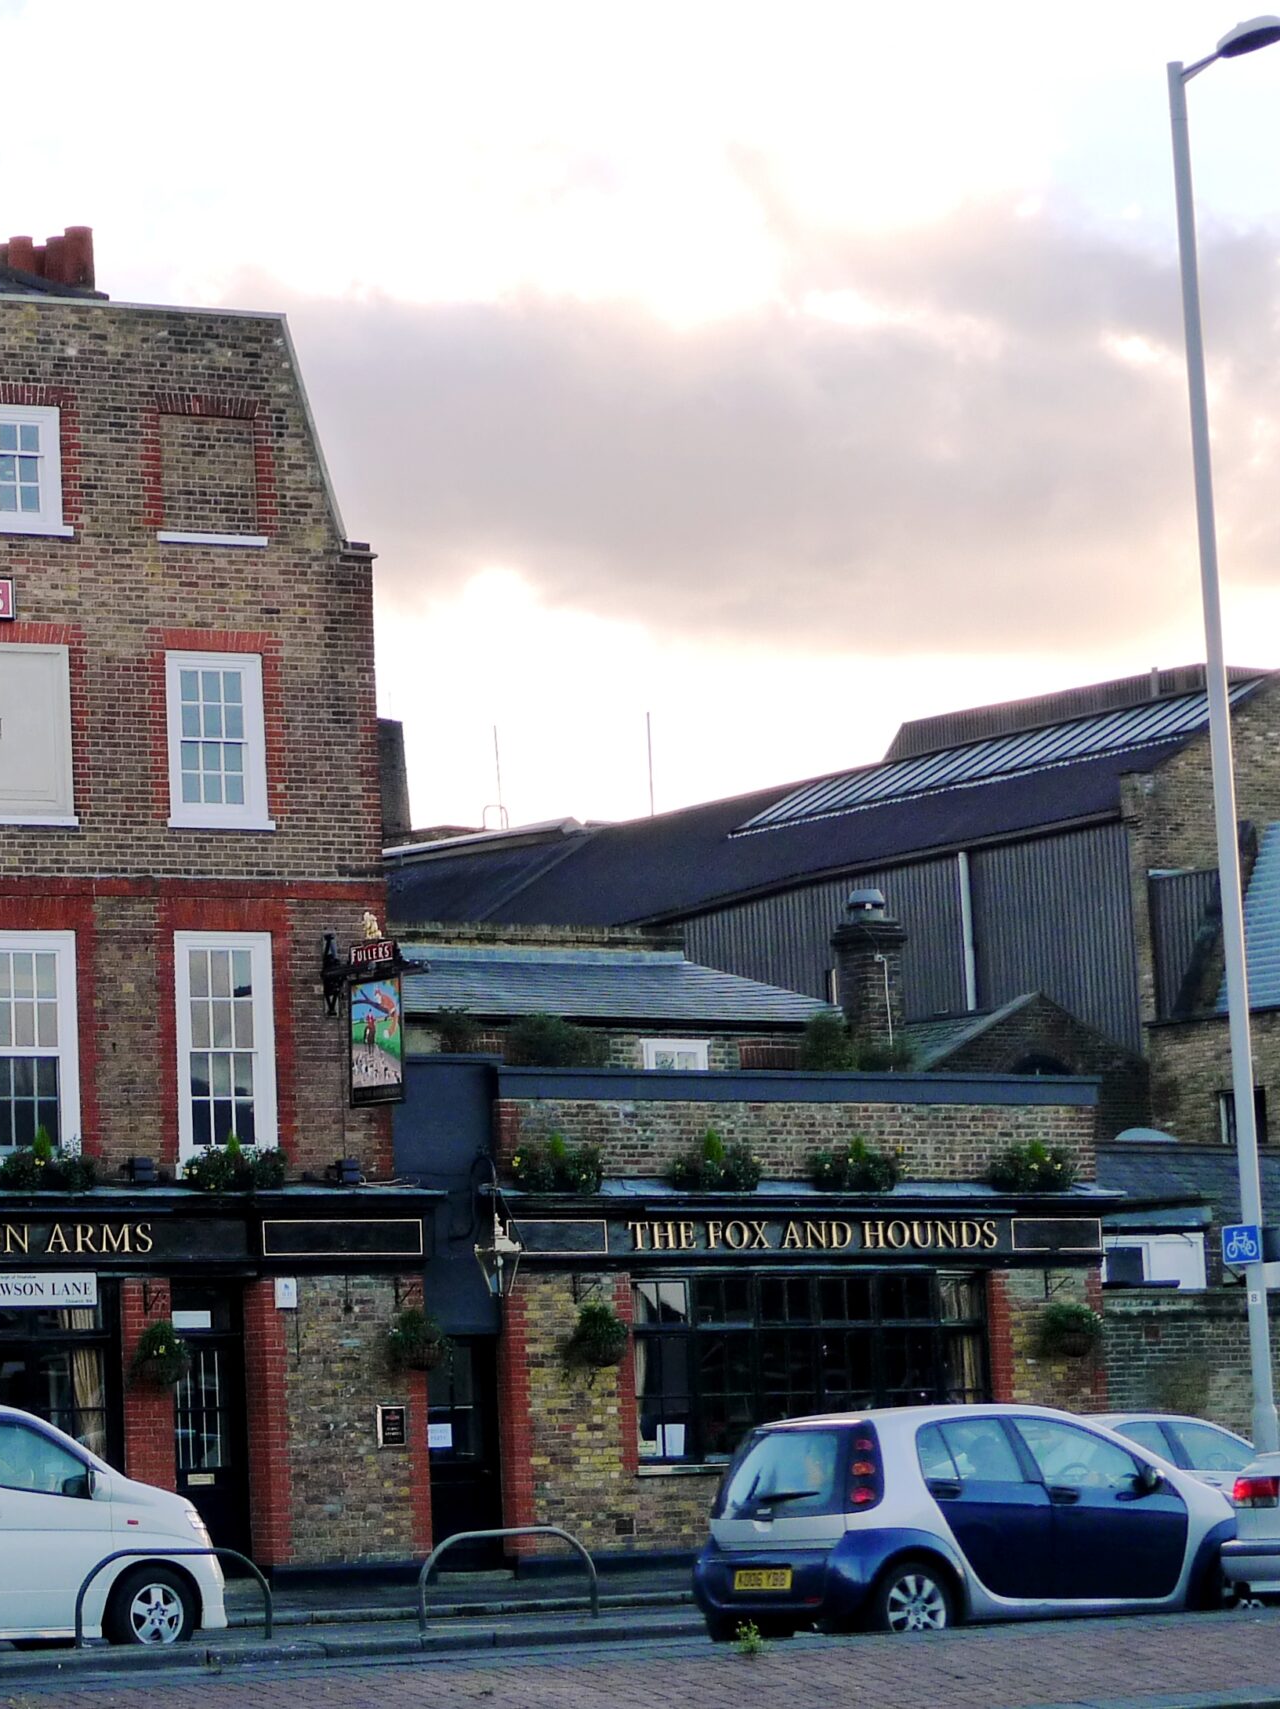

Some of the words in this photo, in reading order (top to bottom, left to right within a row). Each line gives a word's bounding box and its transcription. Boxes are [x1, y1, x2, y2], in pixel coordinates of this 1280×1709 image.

[44, 1222, 154, 1254] ARMS
[628, 1220, 697, 1250] THE
[705, 1219, 772, 1250] FOX
[781, 1220, 853, 1249] AND
[862, 1219, 999, 1249] HOUNDS
[51, 1282, 93, 1296] LANE
